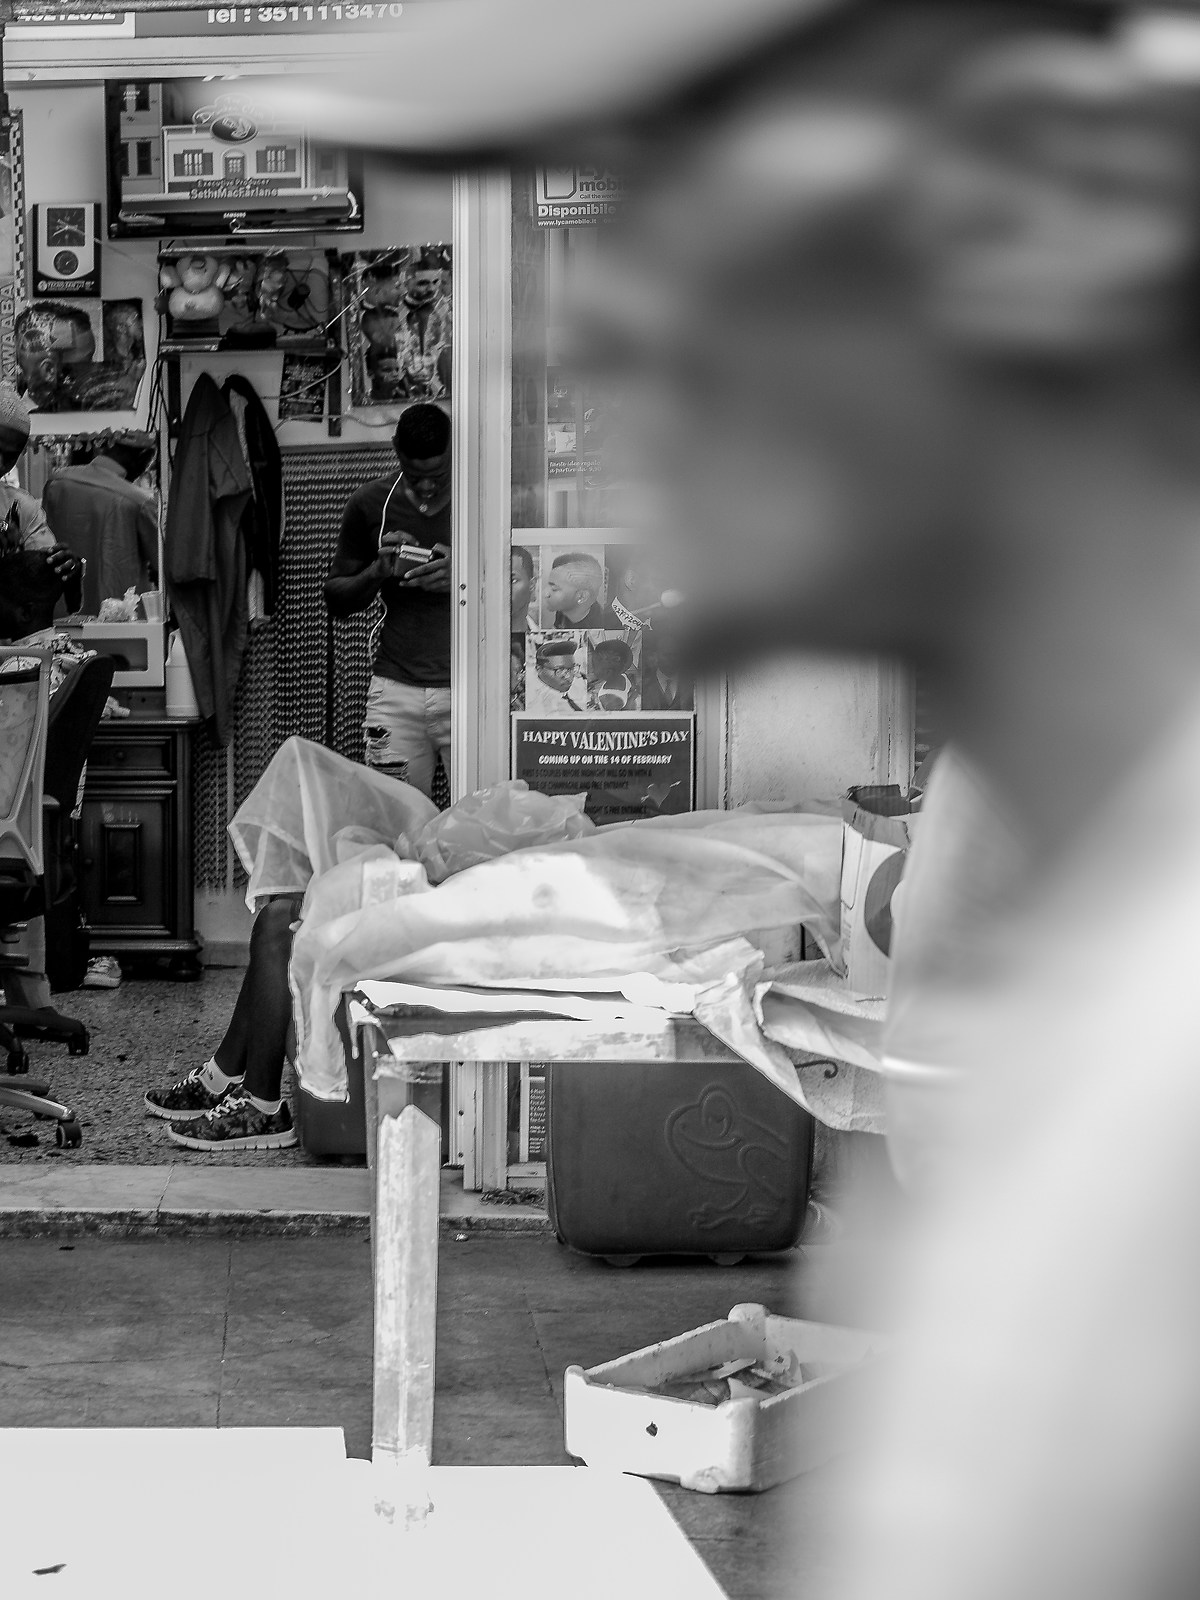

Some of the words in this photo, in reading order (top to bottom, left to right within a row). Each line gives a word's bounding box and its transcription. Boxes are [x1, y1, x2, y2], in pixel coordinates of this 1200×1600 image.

[258, 3, 404, 23] 3511113470
[217, 187, 279, 199] MacFarlane
[538, 203, 617, 218] Disponibile
[523, 731, 570, 747] HAPPY
[569, 730, 659, 751] VALENTINE'S
[660, 730, 689, 745] DAY
[538, 754, 569, 765] COMING
[569, 755, 581, 765] UP
[581, 755, 593, 765] ON
[594, 755, 609, 765] THE
[610, 755, 621, 765] 14
[621, 755, 632, 765] OF
[632, 754, 672, 765] FEBRUARY
